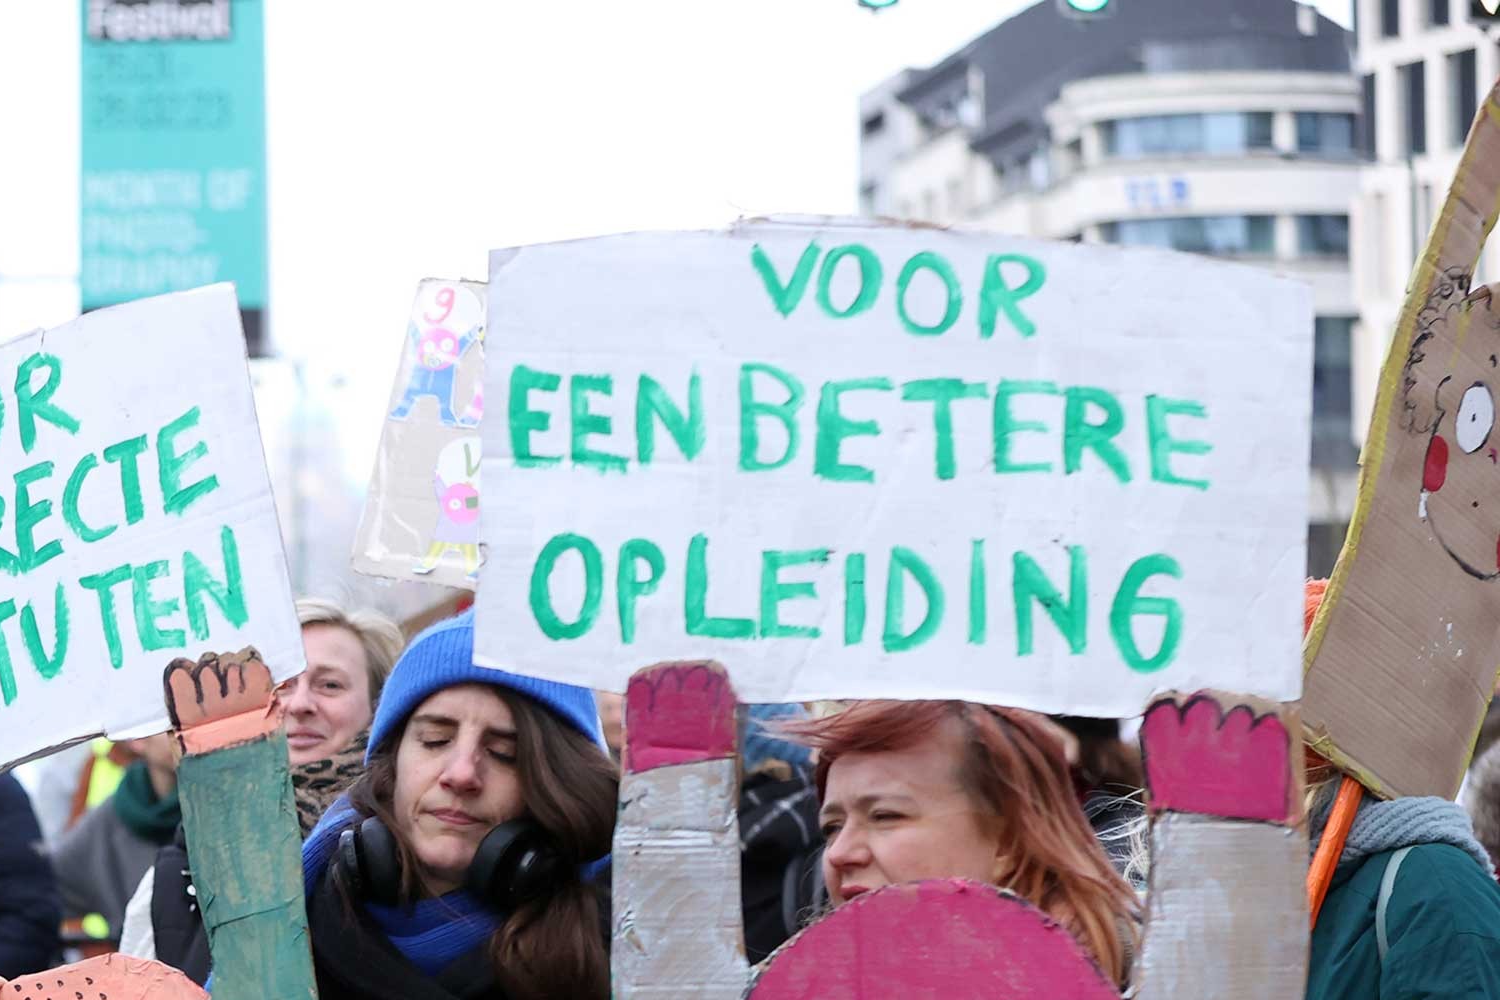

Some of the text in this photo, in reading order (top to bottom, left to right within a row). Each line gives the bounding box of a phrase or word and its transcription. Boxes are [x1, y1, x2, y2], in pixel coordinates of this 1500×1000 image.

[749, 239, 1048, 340] VOOR
[507, 360, 1215, 491] EEN BETERE
[528, 531, 1186, 675] OPLEIDING
